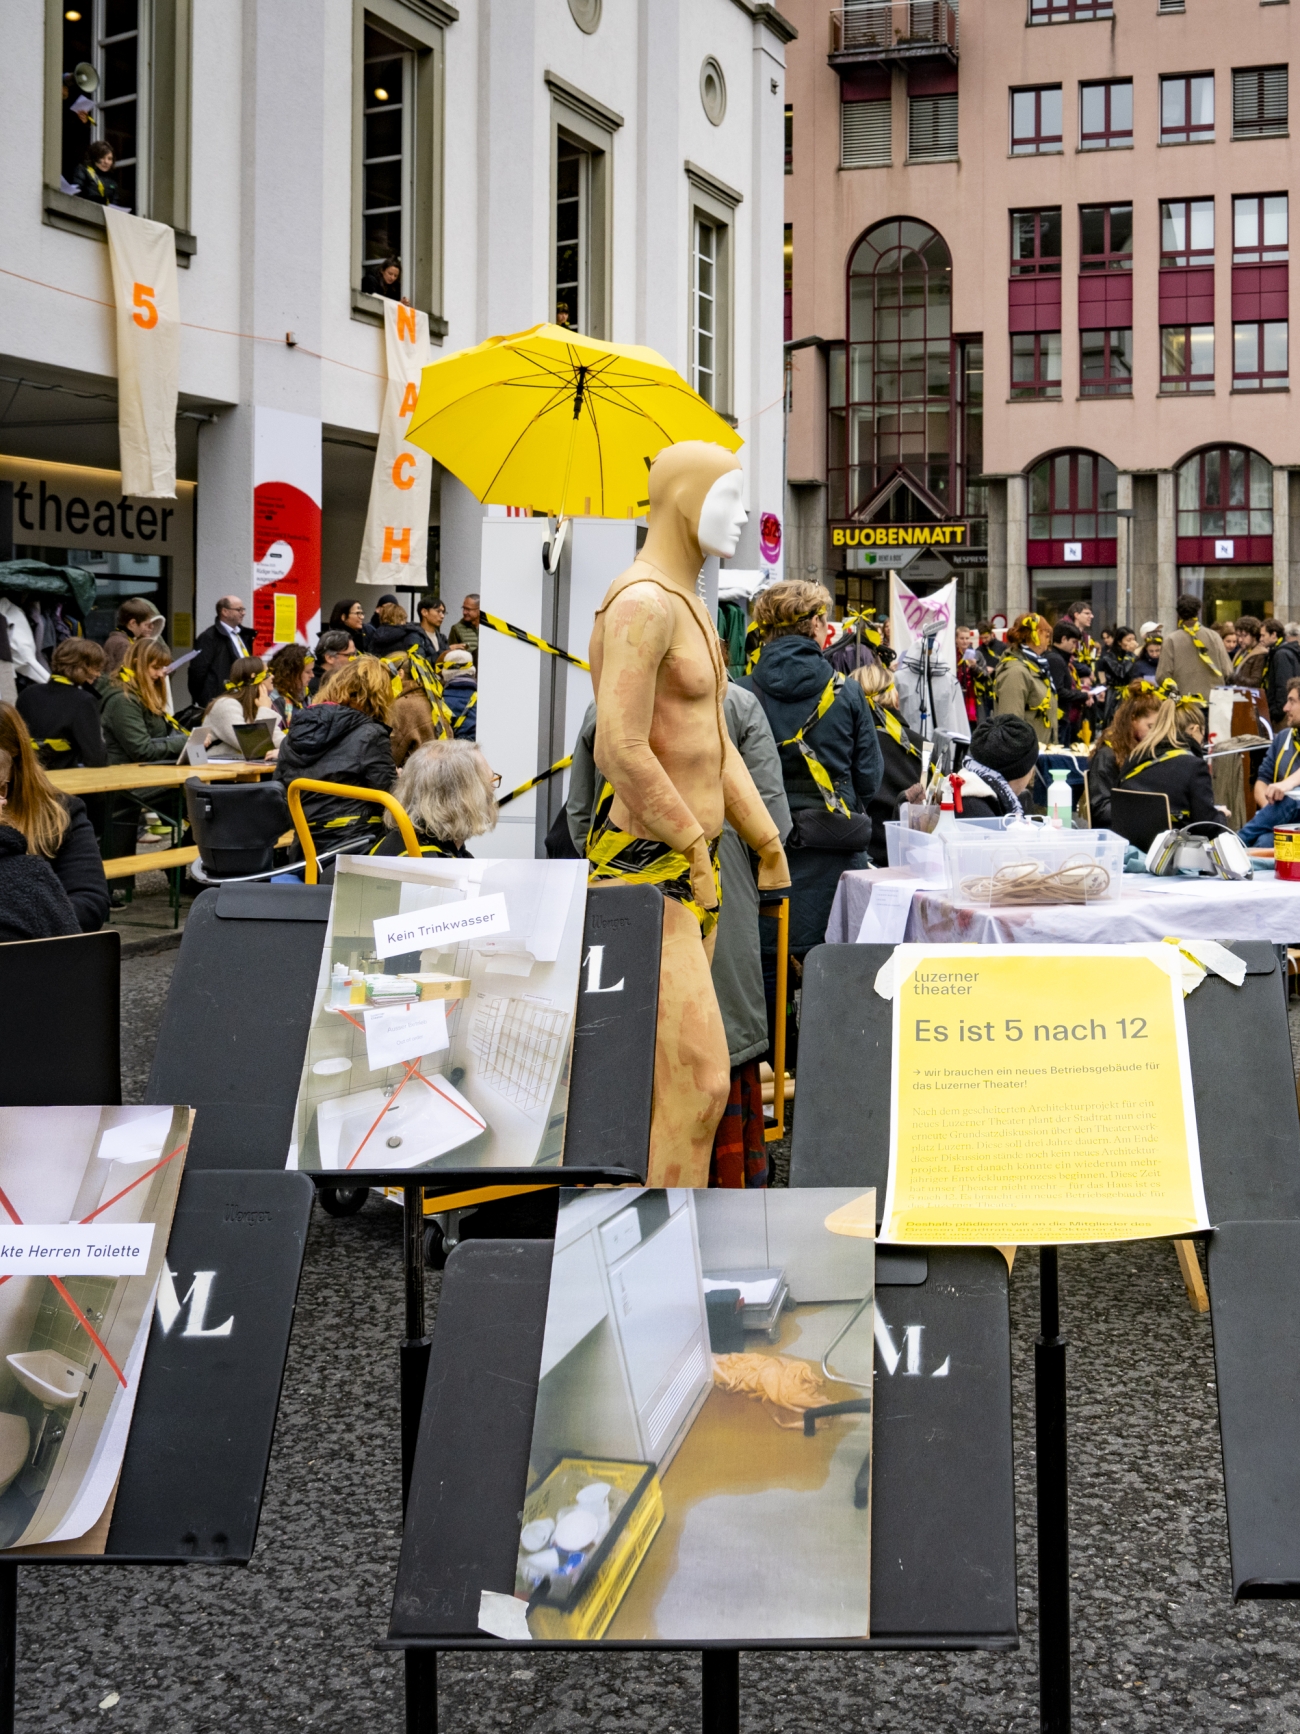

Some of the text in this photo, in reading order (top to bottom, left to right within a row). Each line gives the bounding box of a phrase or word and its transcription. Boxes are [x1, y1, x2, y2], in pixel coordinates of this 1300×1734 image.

[132, 282, 159, 330] 5
[14, 480, 174, 542] theater
[832, 526, 965, 546] BUOBENMATT
[387, 913, 496, 943] Kein Trinkwasser
[914, 970, 979, 983] luzerner
[914, 983, 972, 995] theater
[915, 1017, 1149, 1042] Es ist 5 nach 12
[924, 1062, 1160, 1076] wir brauchen ein neues Betriebsgebäude für
[912, 1079, 1027, 1090] das Luzerner Theater!
[913, 1107, 937, 1116] Nach
[940, 1107, 960, 1115] dem
[962, 1105, 1025, 1116] gescheiterten
[1028, 1101, 1119, 1113] Architekturprojekt
[1122, 1100, 1136, 1108] für
[942, 1119, 985, 1127] Luzerner
[988, 1116, 1025, 1126] Theater
[1028, 1116, 1053, 1125] plant
[1055, 1115, 1071, 1123] der
[1074, 1113, 1112, 1122] Stadtrat
[1136, 1111, 1157, 1119] eine
[912, 1123, 1158, 1140] erneute Grundsatzdiskussion über den Theaterwerk-
[912, 1144, 935, 1153] platz
[938, 1143, 973, 1151] Luzern.
[977, 1141, 1002, 1149] Diese
[1005, 1140, 1022, 1148] soll
[1024, 1138, 1044, 1147] drei
[1075, 1137, 1111, 1145] dauern.
[1114, 1135, 1131, 1144] Am
[1134, 1134, 1158, 1142] Ende
[941, 1153, 990, 1161] Diskussion
[1026, 1150, 1048, 1158] noch
[1051, 1149, 1070, 1158] kein
[911, 1165, 950, 1174] projekt.
[977, 1163, 1013, 1171] danach
[1017, 1162, 1052, 1170] könnte
[1055, 1161, 1071, 1169] ein
[1075, 1160, 1127, 1168] wiederum
[951, 1173, 1056, 1182] Entwicklungsprozess
[1059, 1172, 1107, 1180] beginnen.
[1110, 1170, 1137, 1178] Diese
[1001, 1183, 1027, 1191] nicht
[28, 1245, 81, 1257] Herren
[86, 1244, 140, 1257] Toilette
